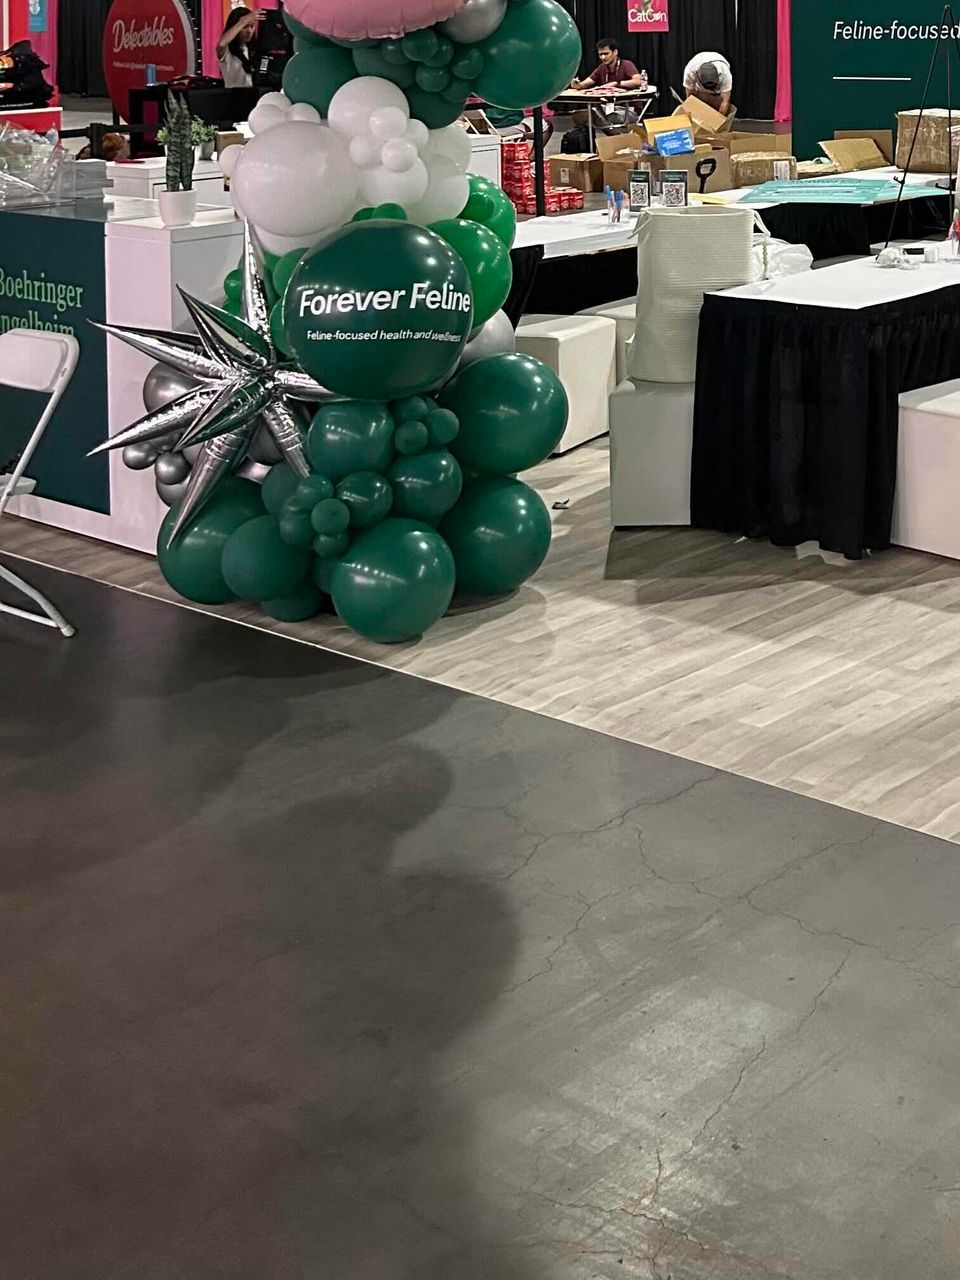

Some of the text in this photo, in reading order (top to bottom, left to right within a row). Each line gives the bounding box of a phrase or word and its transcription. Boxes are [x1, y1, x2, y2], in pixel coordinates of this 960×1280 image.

[112, 15, 175, 53] Delectables
[299, 281, 471, 317] Forever Feline
[307, 329, 379, 341] Feline-focused
[379, 328, 413, 340] health
[414, 329, 432, 340] and
